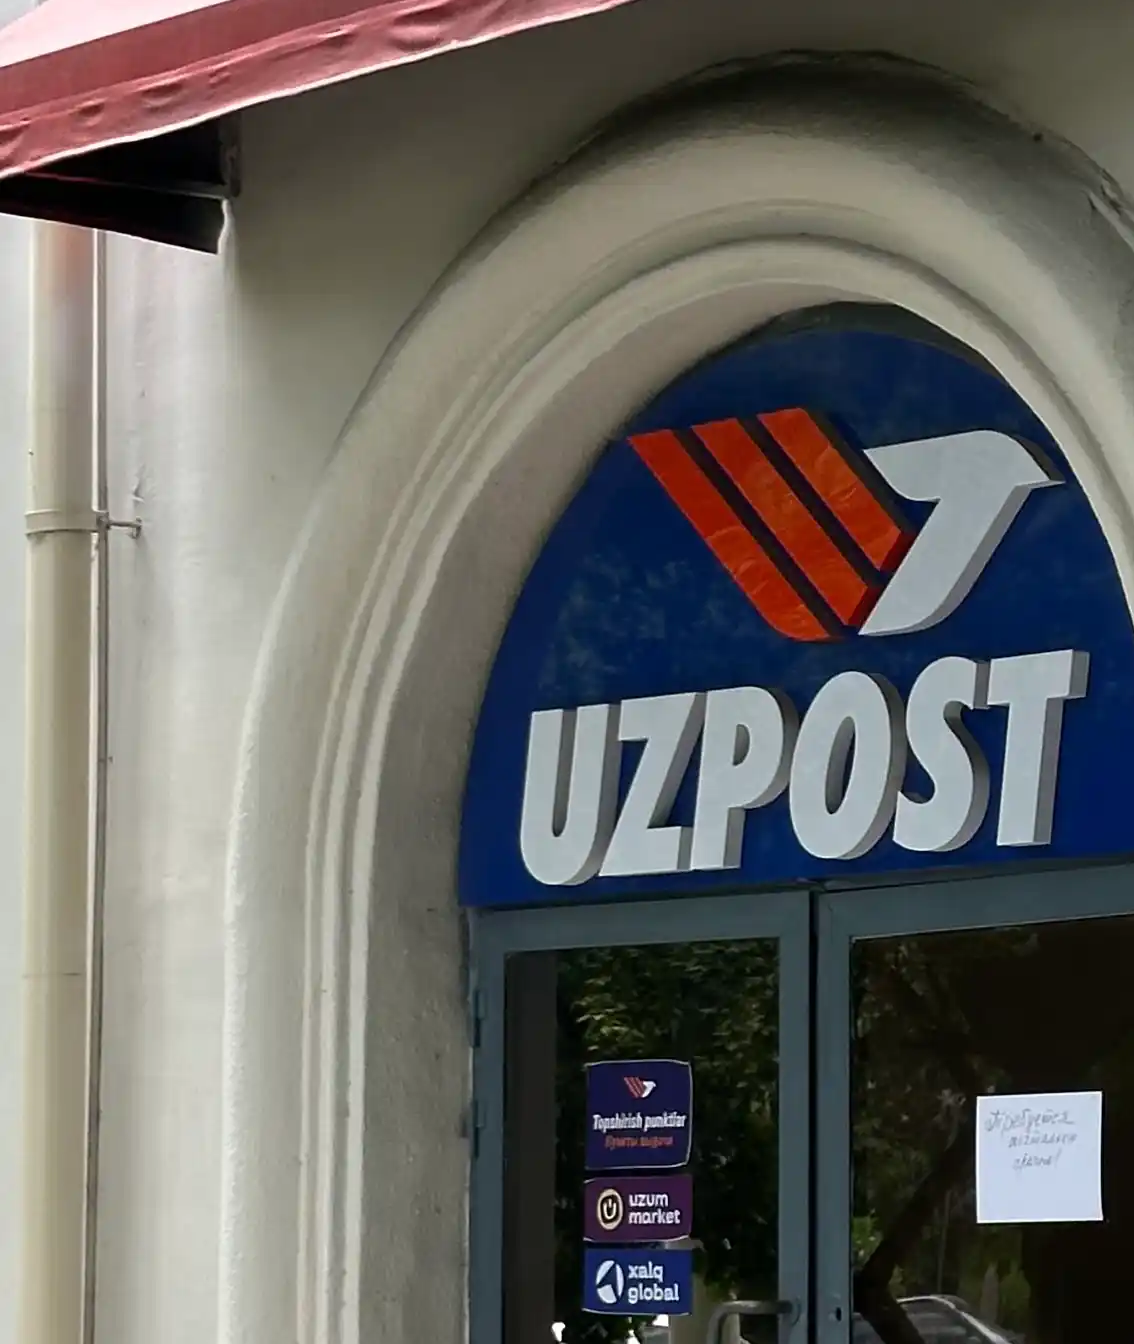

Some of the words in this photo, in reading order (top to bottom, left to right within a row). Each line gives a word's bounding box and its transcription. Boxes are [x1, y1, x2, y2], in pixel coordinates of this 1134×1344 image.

[520, 649, 1090, 886] UZPOST
[628, 1193, 669, 1207] uzum
[628, 1208, 681, 1224] market
[628, 1260, 664, 1283] xalq
[628, 1283, 680, 1304] global
